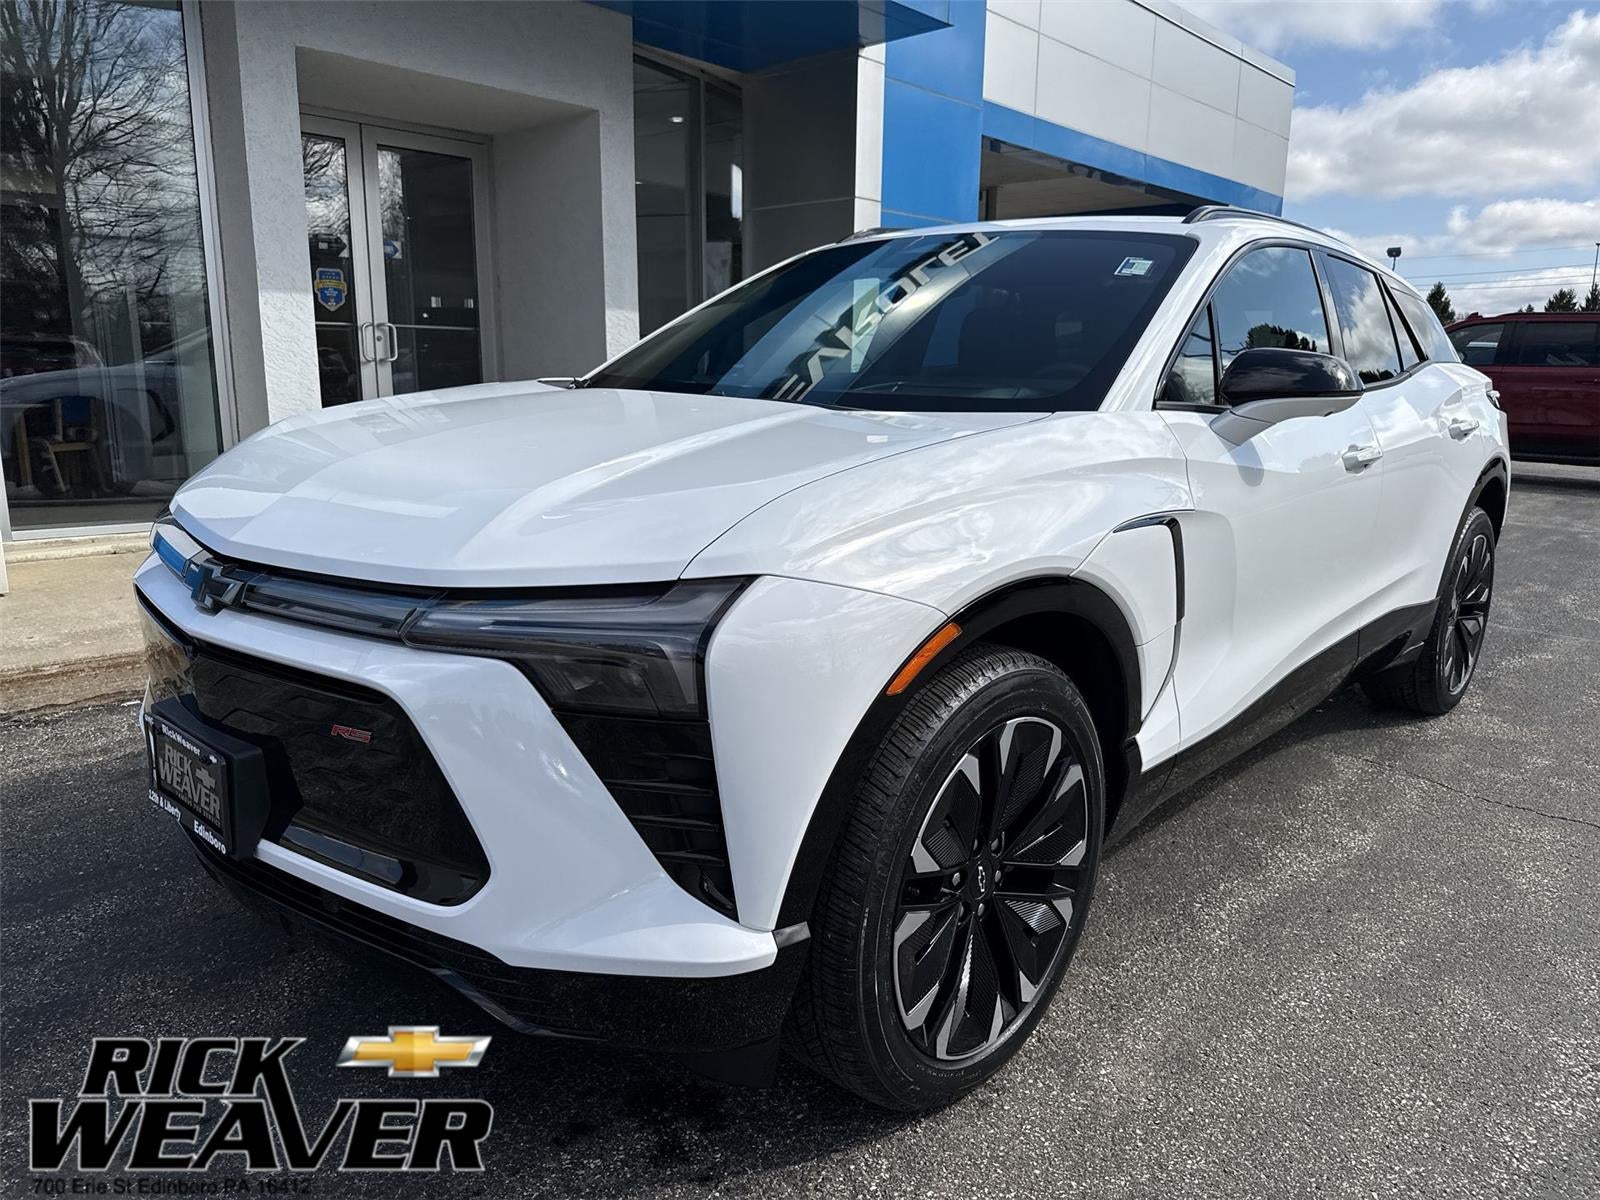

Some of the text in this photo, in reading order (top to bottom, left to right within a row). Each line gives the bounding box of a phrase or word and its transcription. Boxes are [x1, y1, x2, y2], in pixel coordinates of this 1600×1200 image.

[331, 725, 371, 743] RS
[164, 743, 192, 776] RICK
[159, 757, 221, 820] WEAVER
[194, 819, 226, 855] Edinboro
